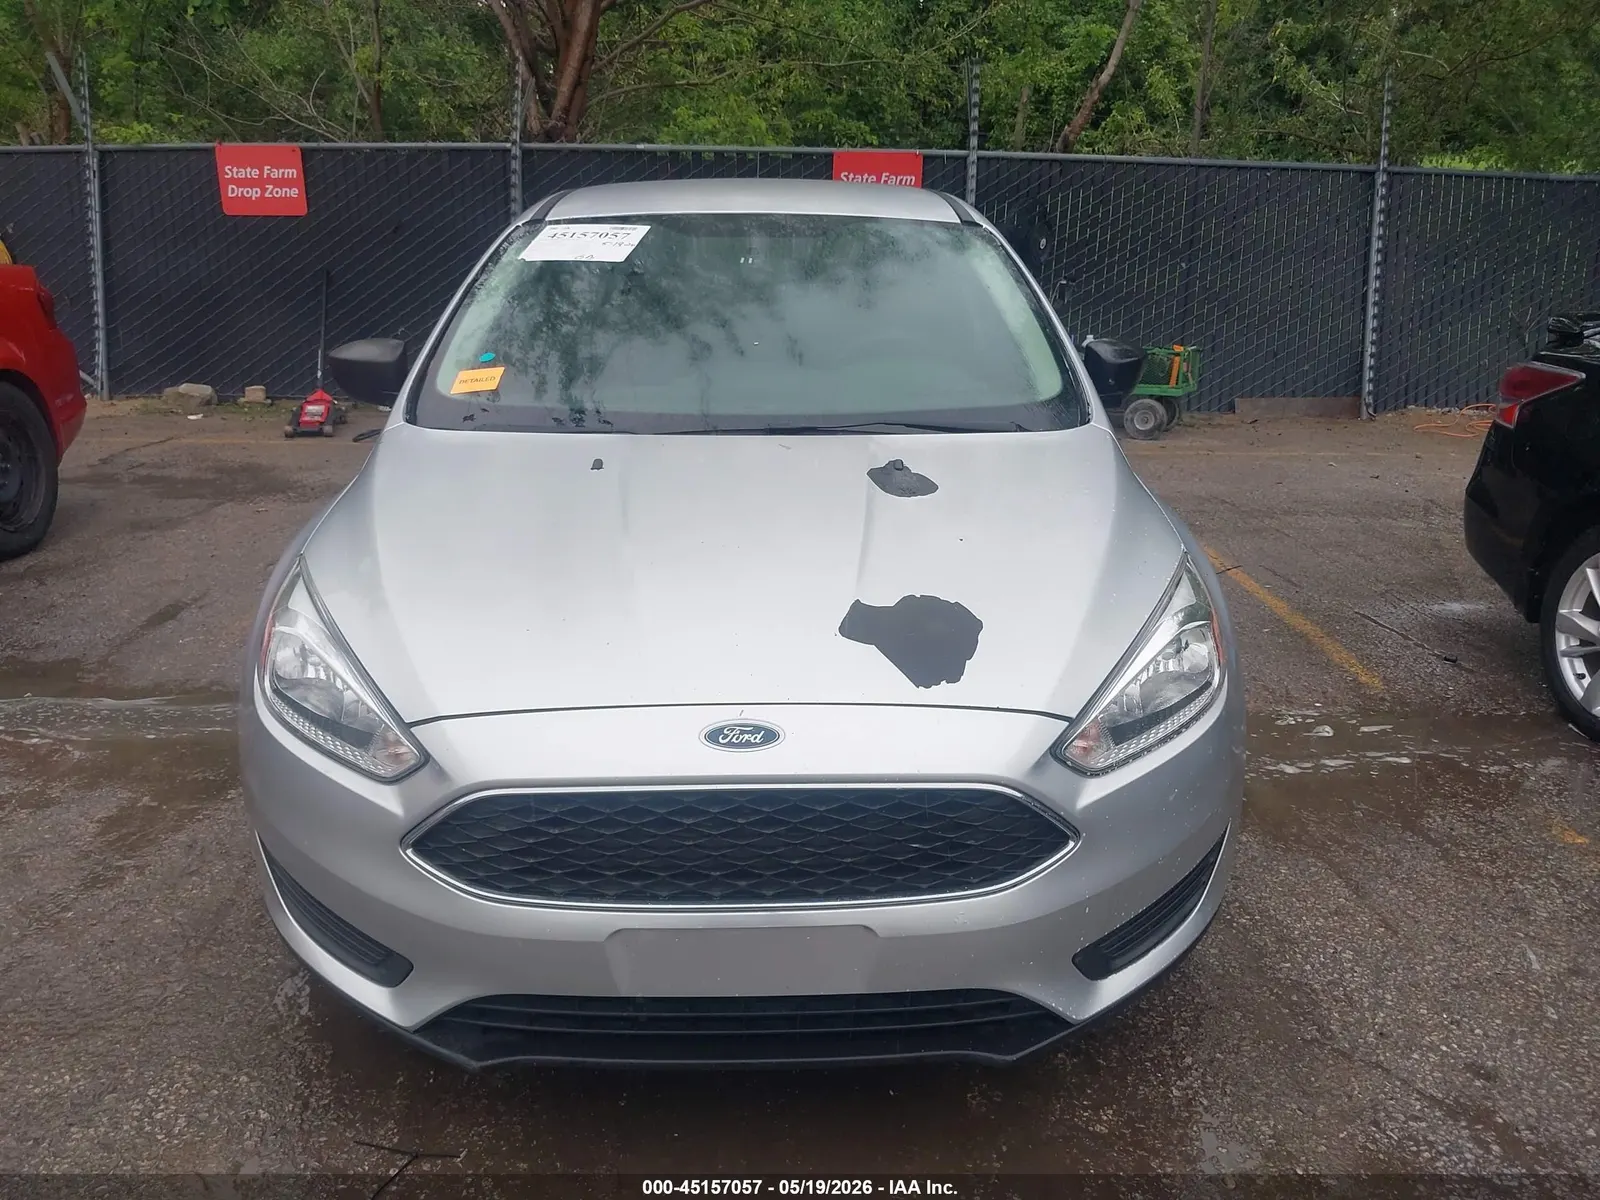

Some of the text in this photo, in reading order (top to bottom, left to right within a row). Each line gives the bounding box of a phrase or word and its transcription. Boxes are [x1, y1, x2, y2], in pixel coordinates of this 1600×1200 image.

[224, 165, 297, 179] State Farm
[840, 171, 916, 186] State Farm
[228, 184, 299, 200] Drop Zone
[548, 231, 631, 241] 45157057
[718, 726, 765, 744] Ford
